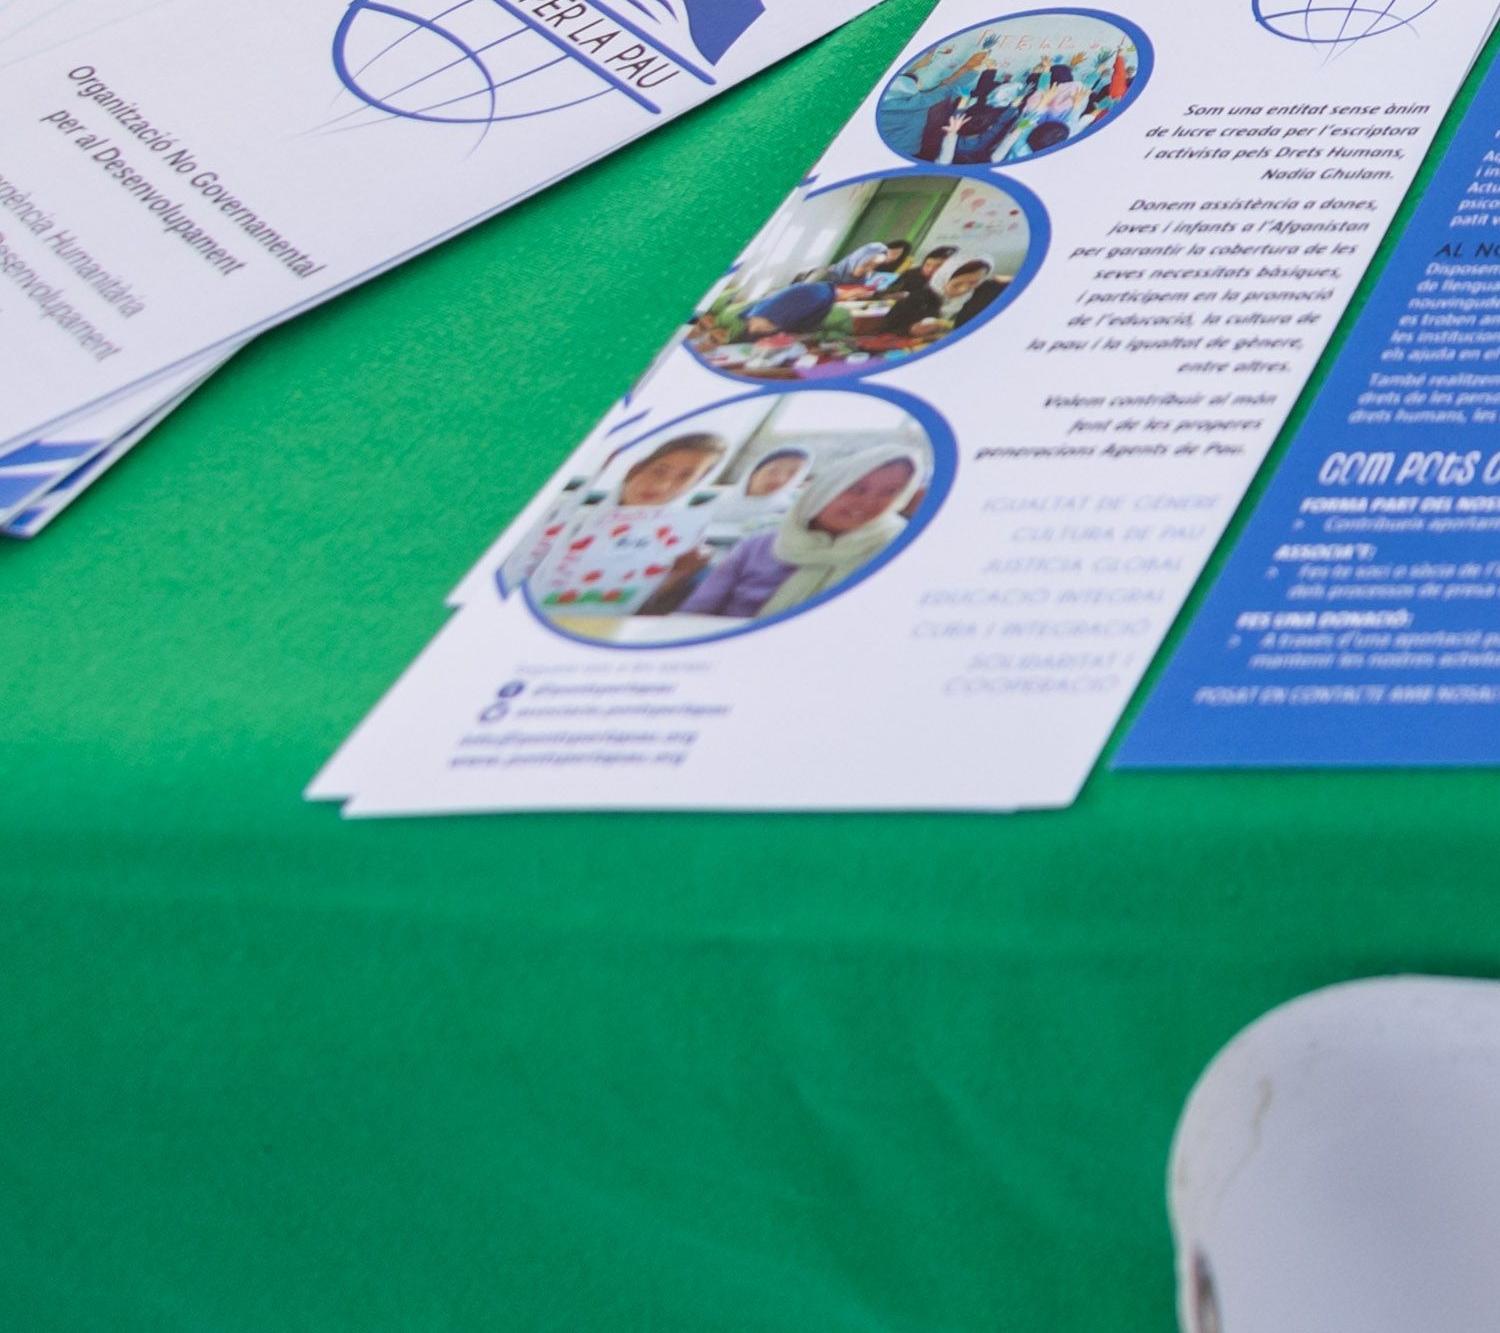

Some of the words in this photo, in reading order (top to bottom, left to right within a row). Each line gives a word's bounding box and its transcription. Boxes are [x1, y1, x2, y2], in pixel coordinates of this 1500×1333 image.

[568, 18, 620, 53] LA
[605, 43, 679, 88] PAU
[1184, 104, 1224, 116] Som
[1227, 106, 1263, 115] una
[1266, 104, 1328, 115] entitat
[1330, 106, 1381, 115] sense
[1384, 103, 1430, 115] ànim
[39, 108, 86, 136] per
[1145, 126, 1169, 137] de
[1171, 125, 1217, 137] lucre
[1219, 125, 1281, 137] creada
[1282, 127, 1315, 139] per
[1318, 124, 1420, 138] l'escriptora
[74, 131, 110, 153] al
[1154, 148, 1231, 159] activista
[1231, 146, 1269, 160] pels
[1275, 146, 1321, 158] Drets
[1326, 146, 1403, 159] Humans,
[67, 65, 172, 152] Organització
[163, 148, 197, 173] No
[189, 171, 325, 278] Governamental
[1260, 168, 1316, 180] Nadia
[1319, 168, 1392, 179] Ghulam.
[91, 146, 245, 275] Desenvolupament
[1128, 199, 1196, 211] Donem
[1199, 198, 1299, 210] assistència
[1319, 198, 1376, 211] dones,
[1434, 242, 1462, 258] AL
